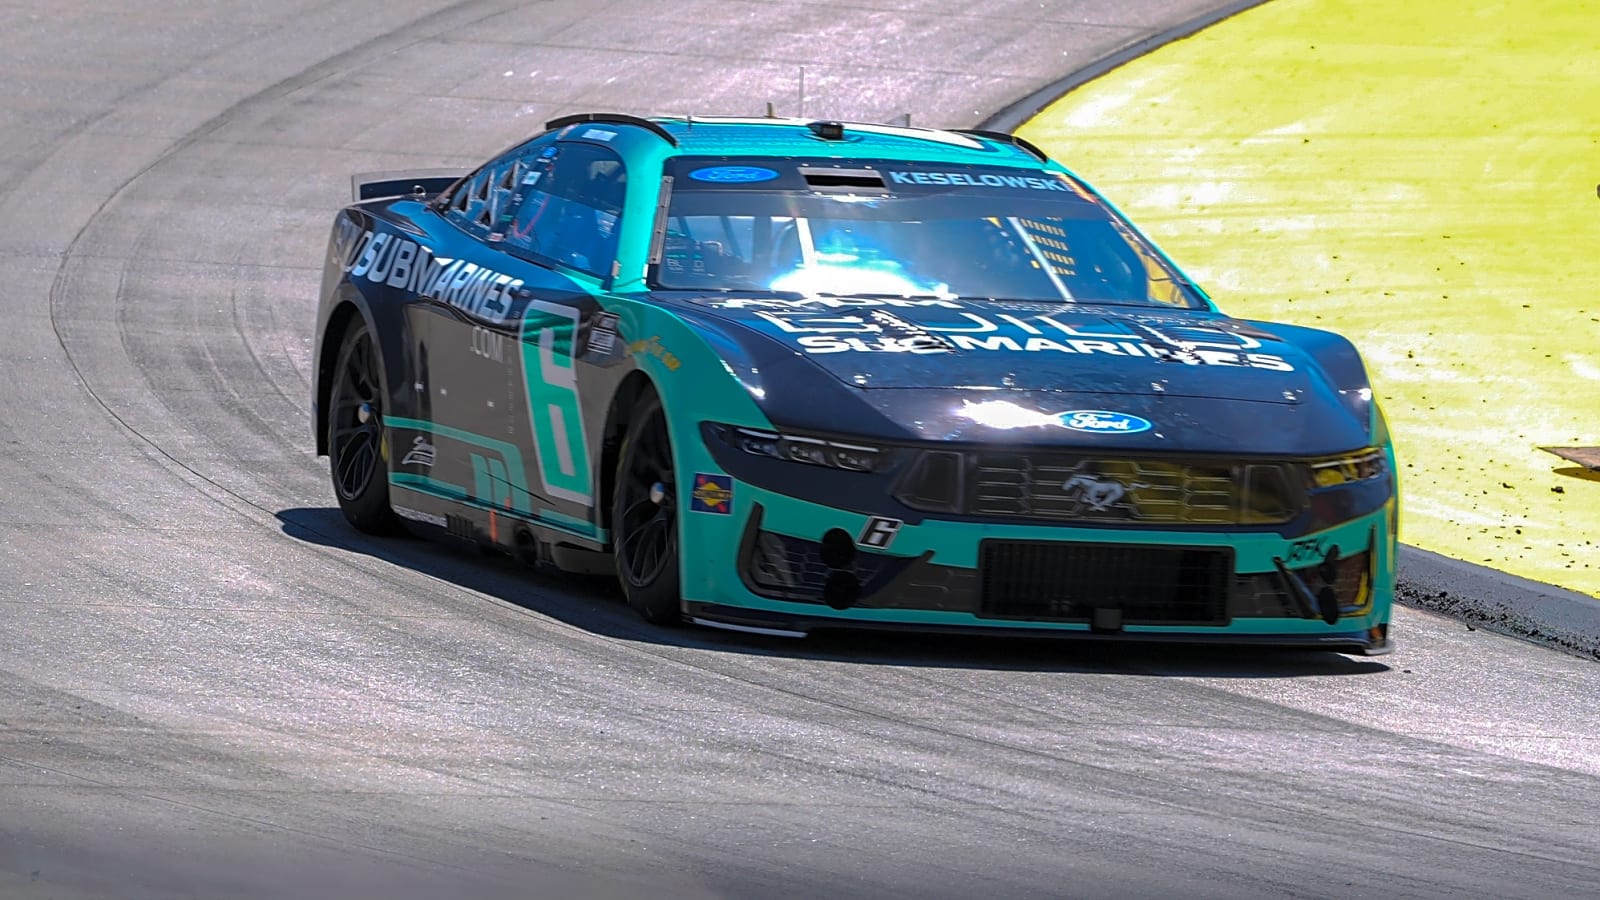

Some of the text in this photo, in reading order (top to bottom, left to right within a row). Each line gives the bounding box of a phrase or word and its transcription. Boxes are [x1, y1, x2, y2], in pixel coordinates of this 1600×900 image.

[888, 171, 1074, 193] KESELOWSKI
[518, 299, 594, 507] 6
[856, 515, 904, 549] 6
